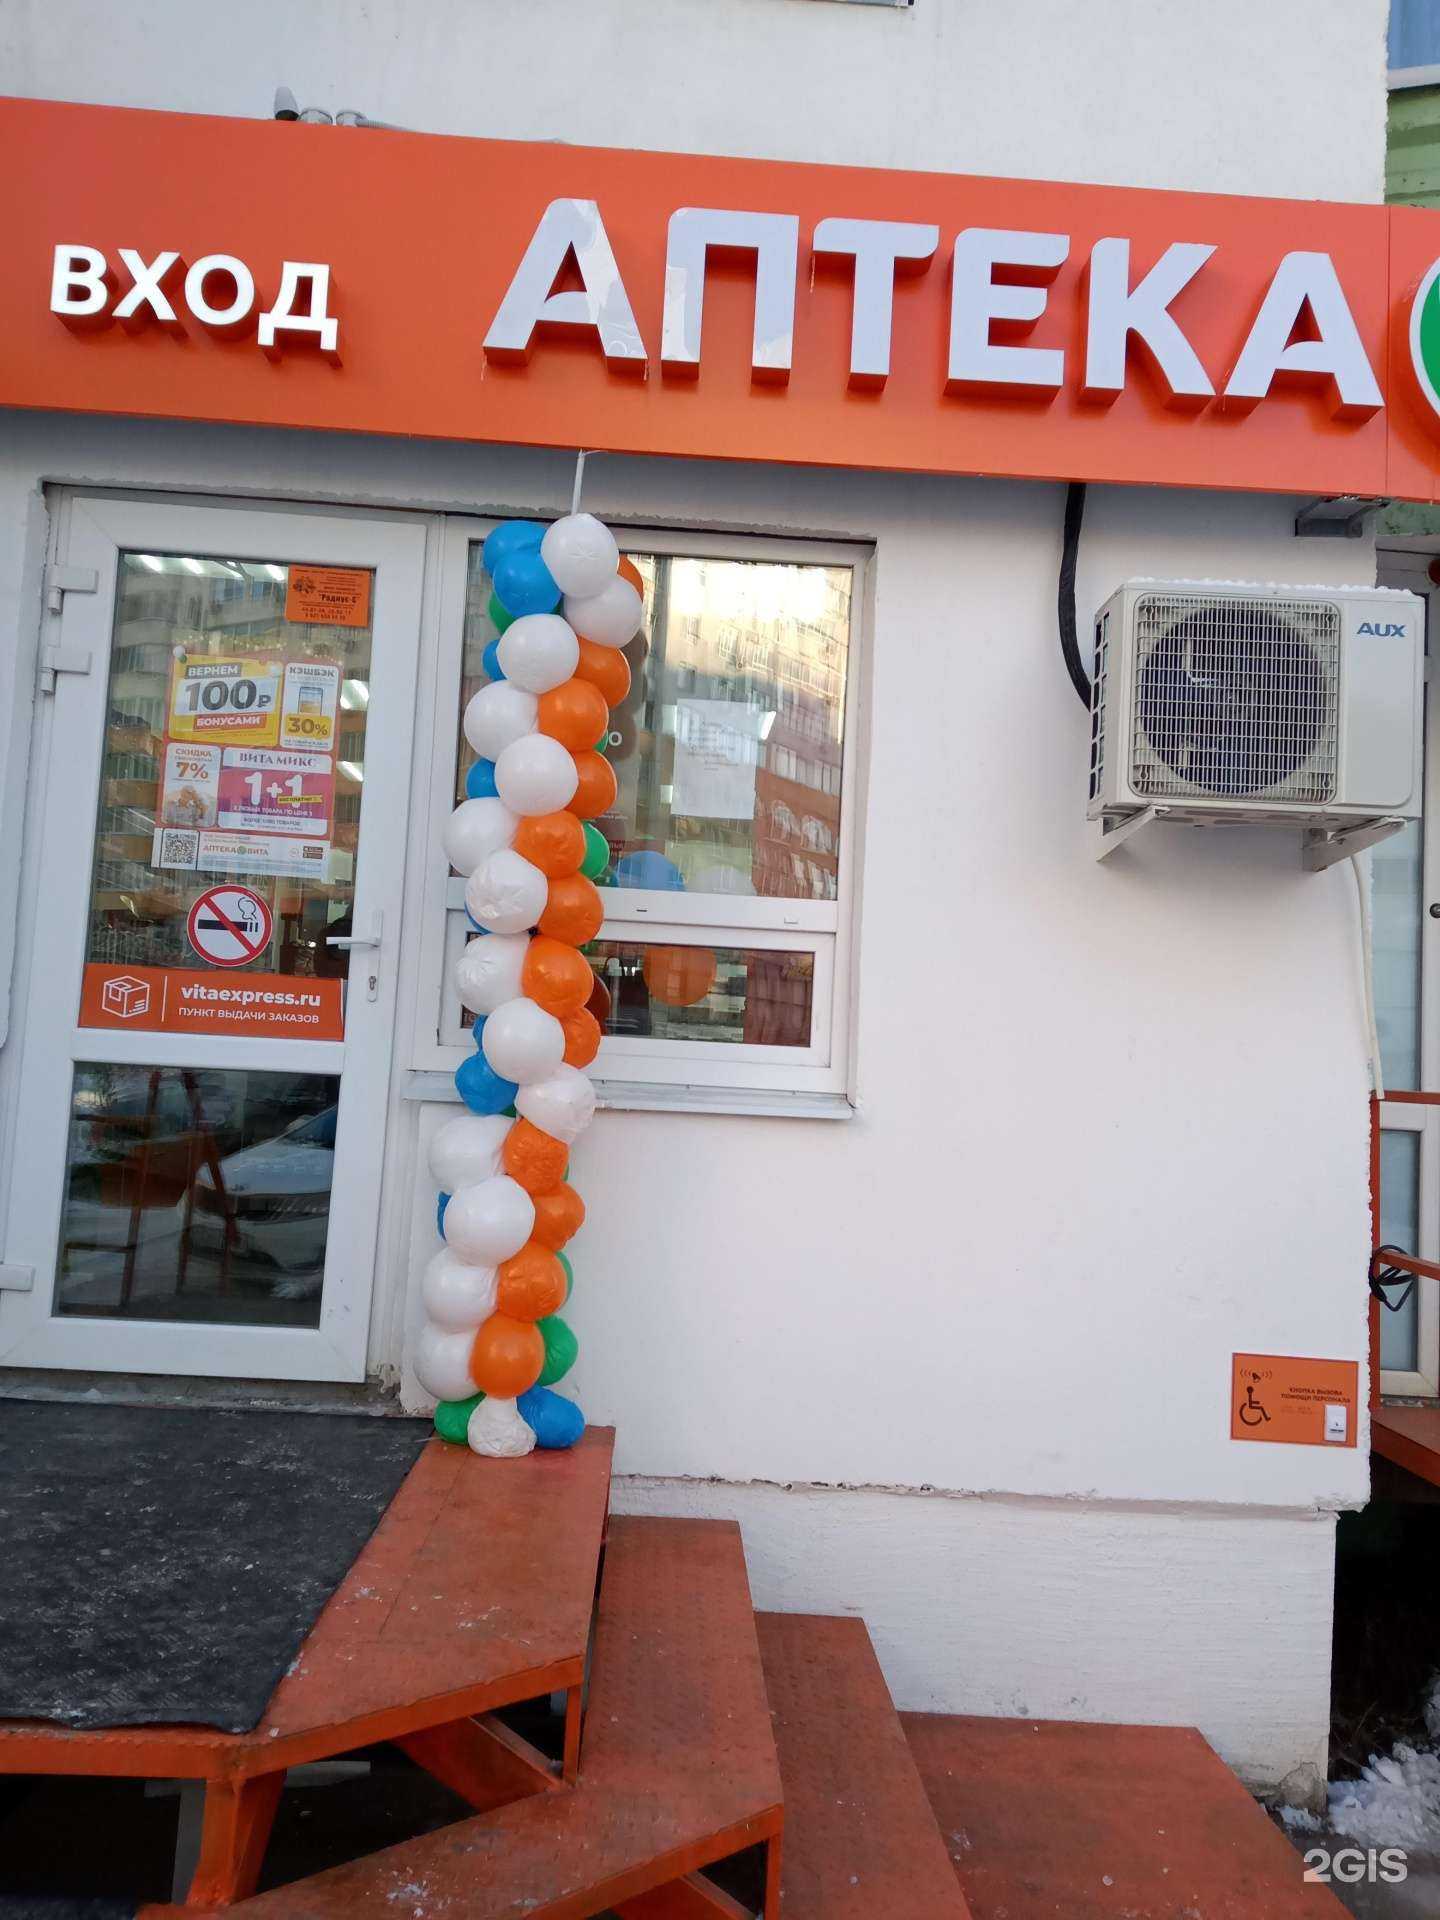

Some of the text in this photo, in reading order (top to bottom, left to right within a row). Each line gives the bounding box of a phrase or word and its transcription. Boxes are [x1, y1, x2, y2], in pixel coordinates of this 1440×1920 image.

[50, 243, 340, 354] ВХОД
[482, 196, 1386, 411] АПТЕКА
[1356, 622, 1406, 638] AUX
[188, 664, 239, 677] ВЕРНЕМ
[289, 666, 335, 678] КЭШБЭК
[196, 715, 261, 727] БОНУСАМИ
[287, 716, 328, 736] 30%
[176, 761, 209, 780] 7%
[181, 984, 321, 1007] vitaexpress.ru
[179, 1007, 320, 1024] ПУНКТ ВЫДАЧИ ЗАКАЗОВ
